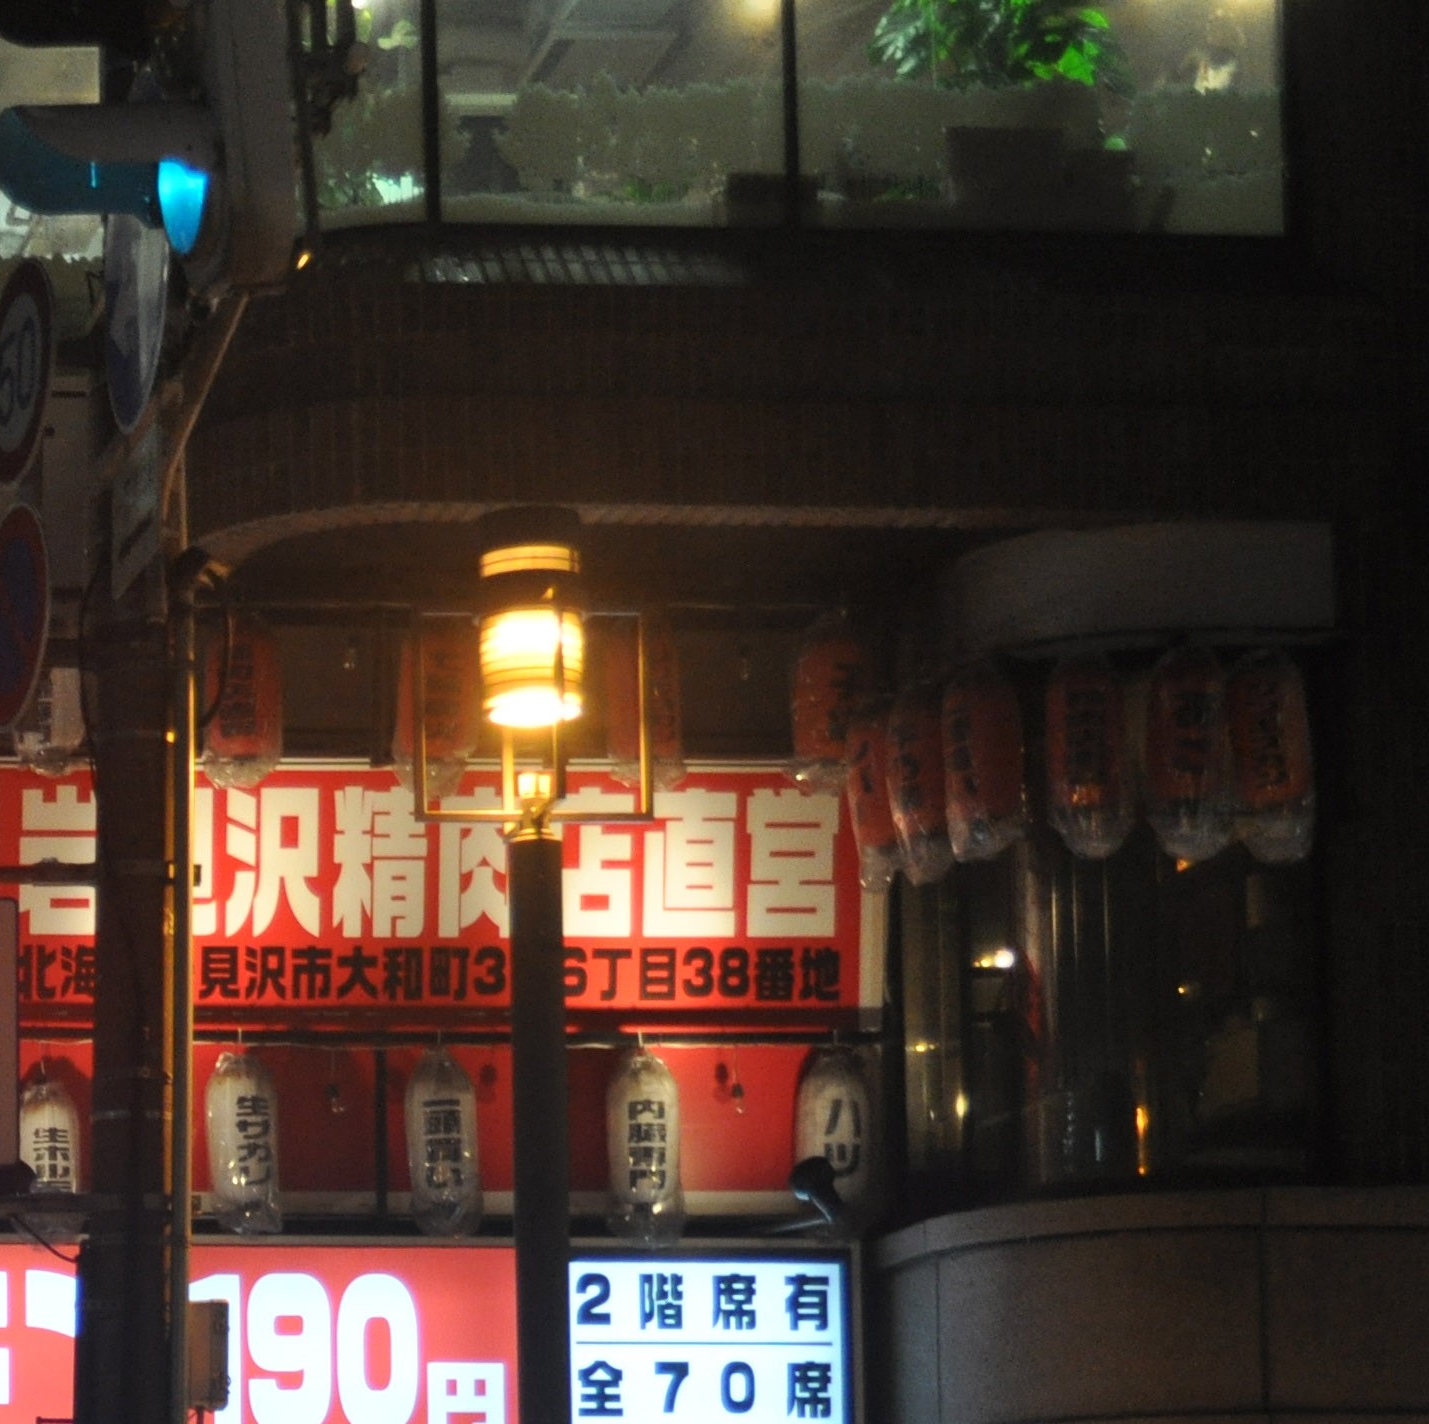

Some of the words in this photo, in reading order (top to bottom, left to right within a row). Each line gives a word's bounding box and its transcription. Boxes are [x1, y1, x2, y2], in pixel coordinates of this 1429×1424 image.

[18, 785, 839, 938] 岩沢精肉店直営
[575, 1272, 831, 1331] 2階席有
[577, 1360, 833, 1419] 全70席
